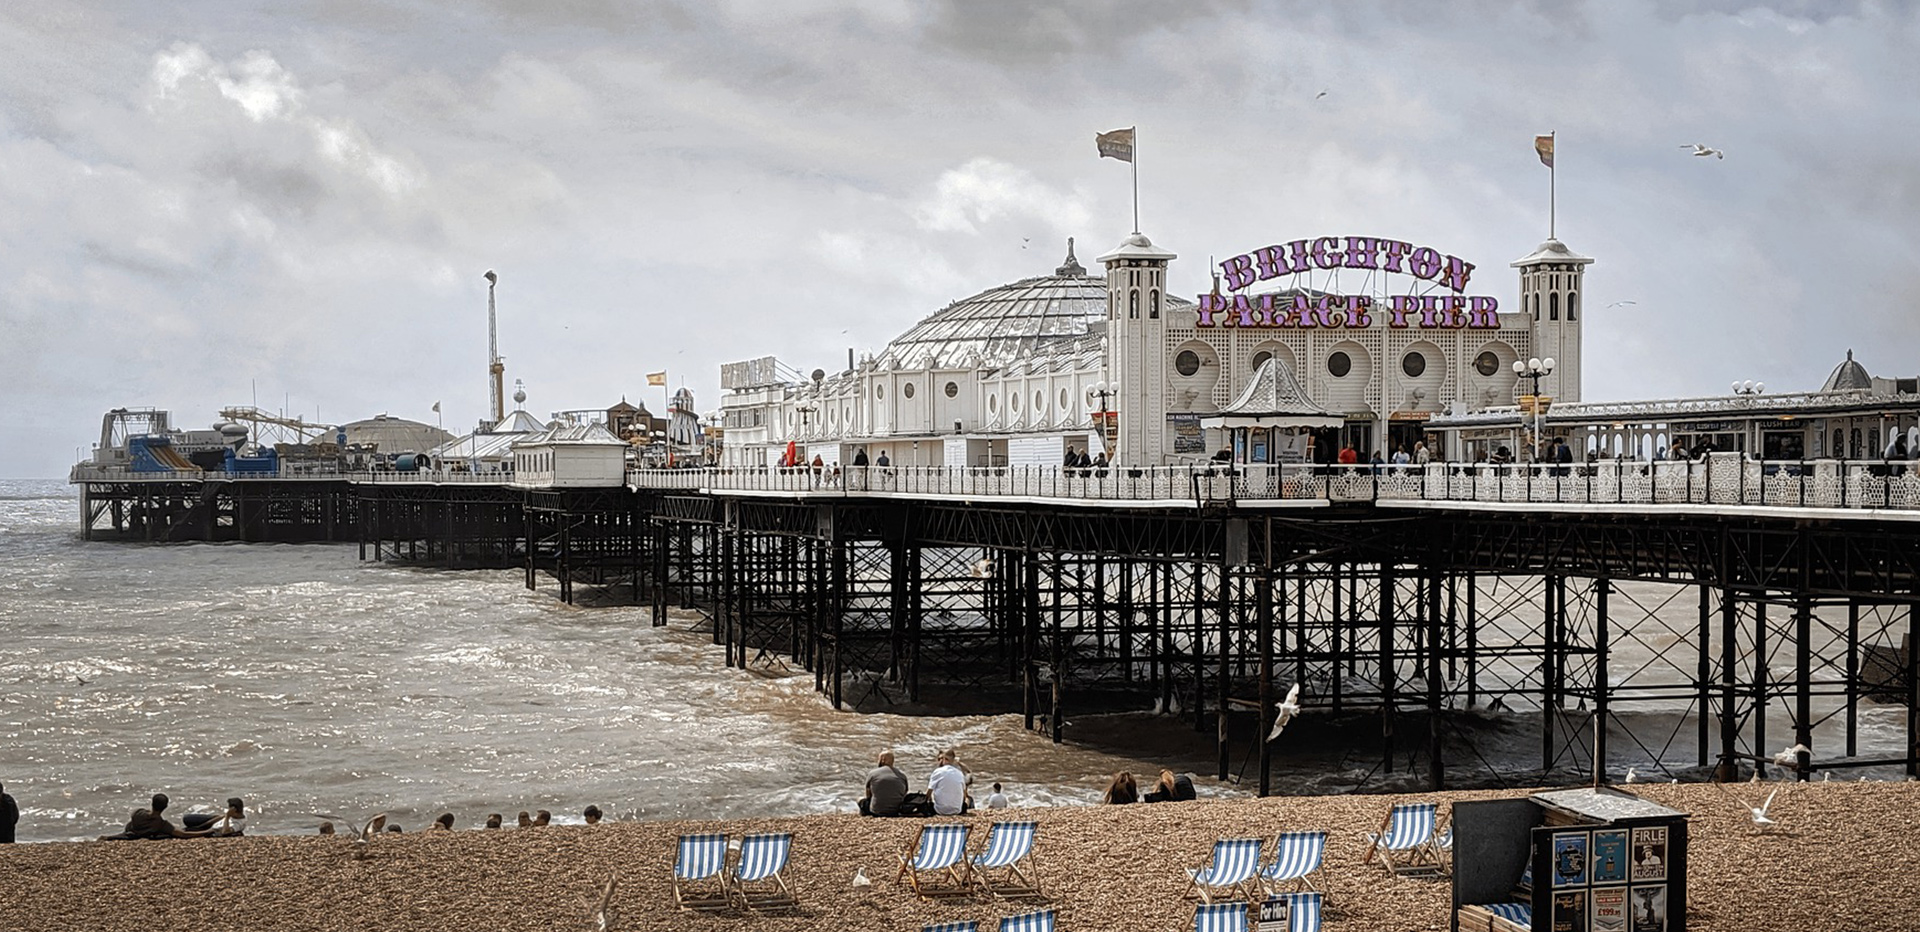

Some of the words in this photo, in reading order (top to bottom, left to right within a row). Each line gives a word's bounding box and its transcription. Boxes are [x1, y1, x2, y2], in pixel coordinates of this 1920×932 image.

[1219, 236, 1476, 293] BRIGHTON
[1196, 294, 1372, 328] PALACE
[1389, 295, 1501, 329] PIER
[1634, 829, 1665, 841] FIRLE
[1634, 870, 1664, 878] AUGUST
[1260, 903, 1272, 920] For
[1272, 902, 1287, 919] Hire
